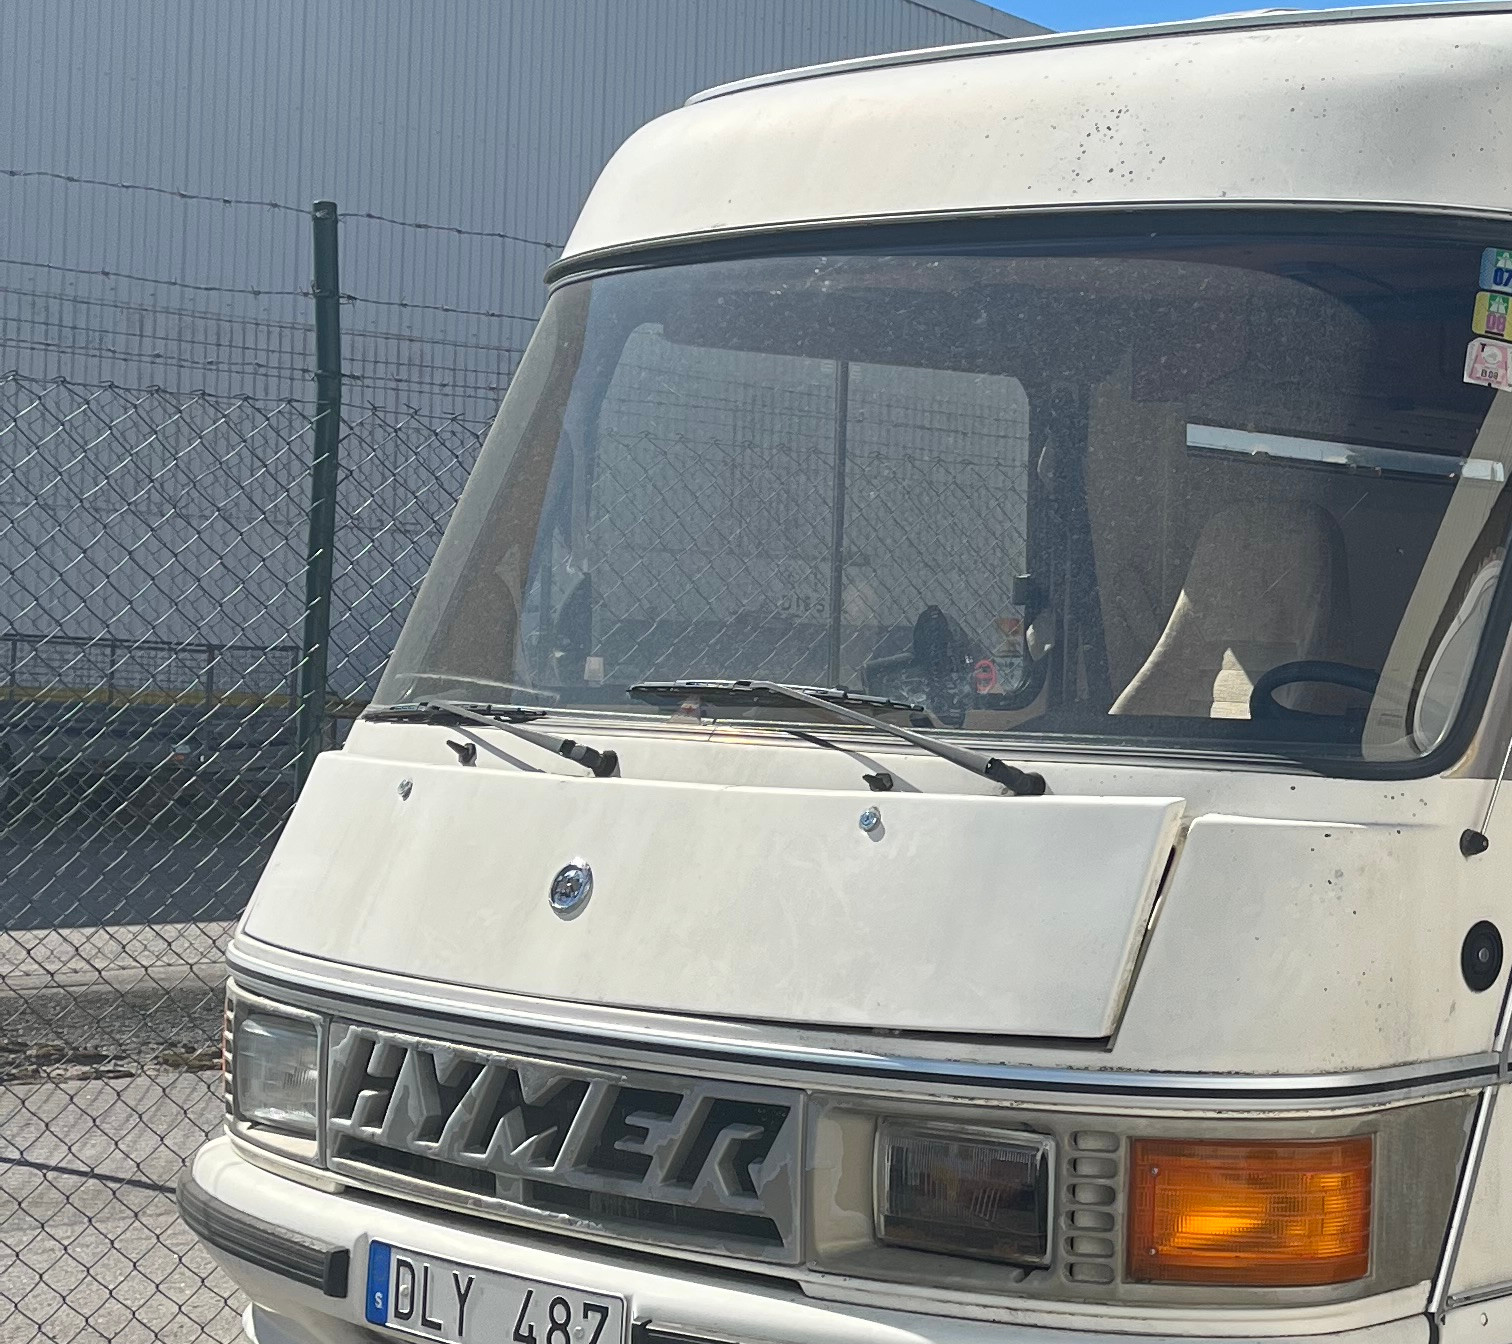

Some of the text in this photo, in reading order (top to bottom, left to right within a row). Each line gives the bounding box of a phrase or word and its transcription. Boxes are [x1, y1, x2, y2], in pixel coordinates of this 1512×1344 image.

[330, 1032, 793, 1199] HYMER
[373, 1290, 384, 1310] S
[393, 1255, 477, 1338] DLY
